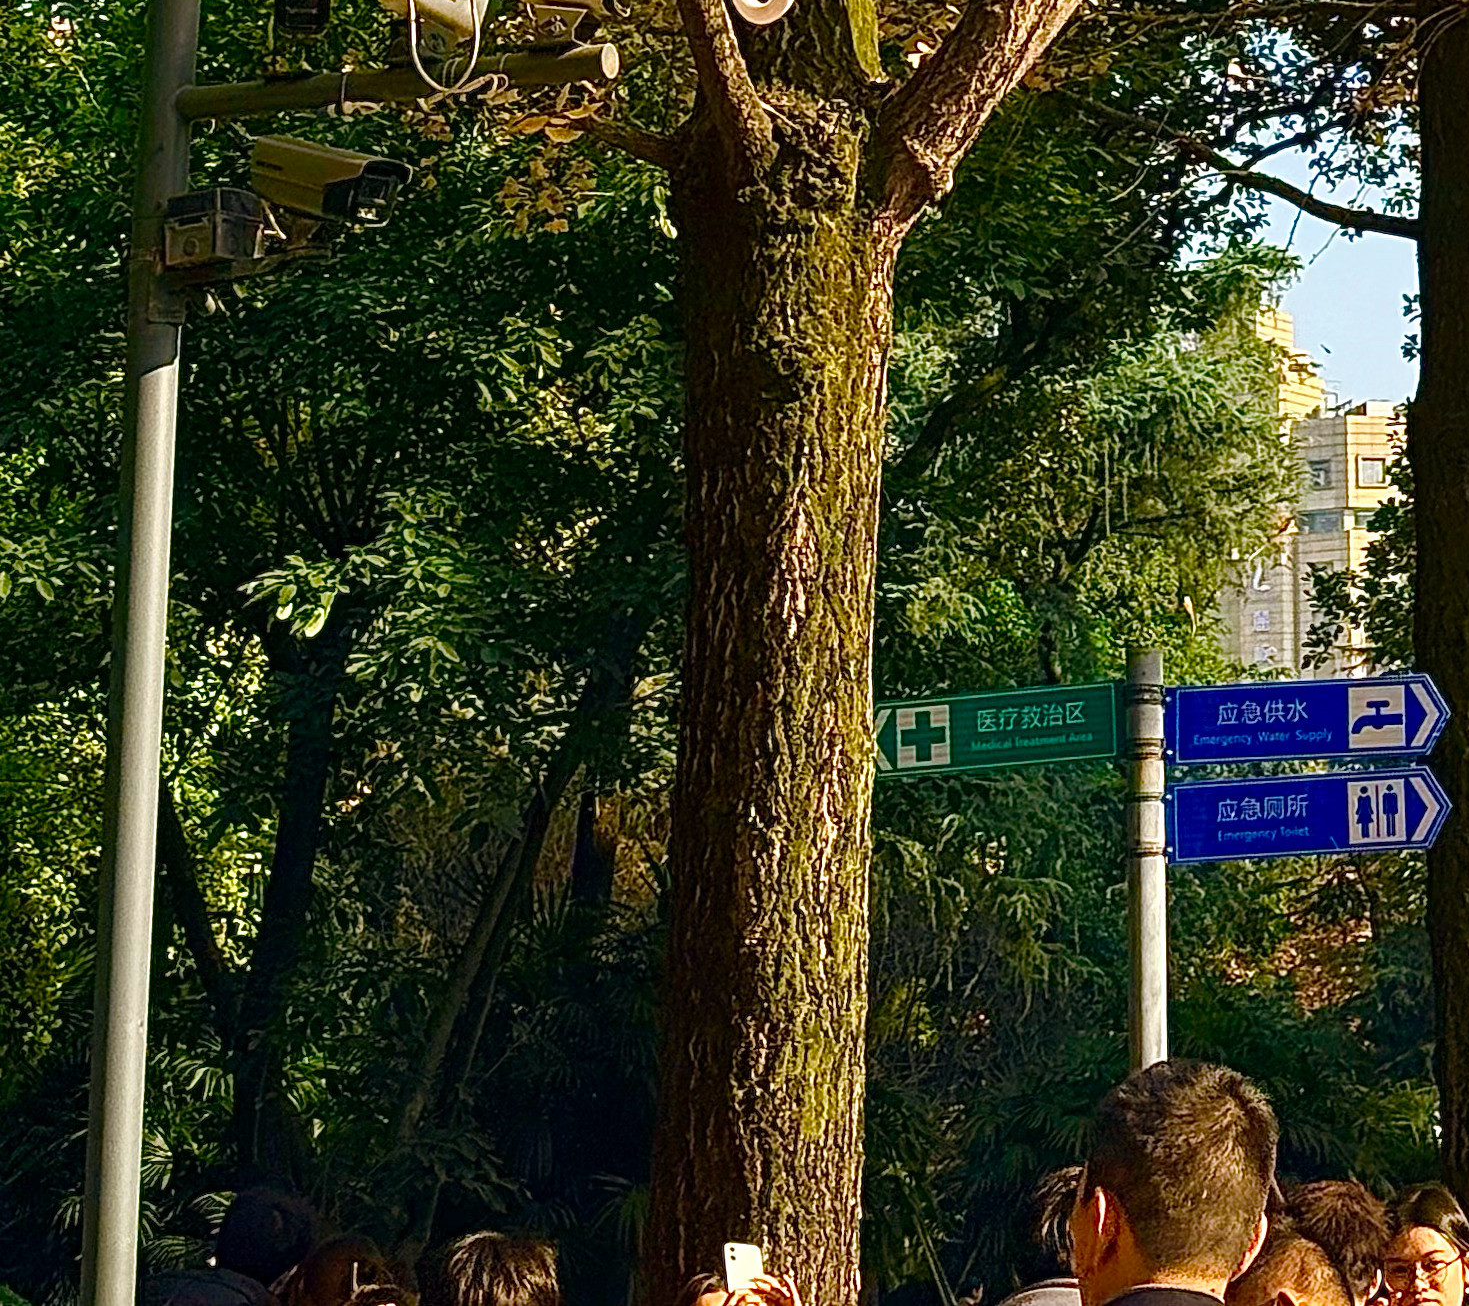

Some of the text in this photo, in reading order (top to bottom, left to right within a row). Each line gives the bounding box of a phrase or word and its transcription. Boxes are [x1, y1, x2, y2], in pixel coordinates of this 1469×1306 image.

[977, 701, 1085, 732] 医疗救治区
[1217, 697, 1308, 726] 应急供水
[1193, 728, 1333, 747] Emergency Water Supply
[1217, 794, 1309, 822] 应急厕所
[1217, 829, 1278, 843] Emergency
